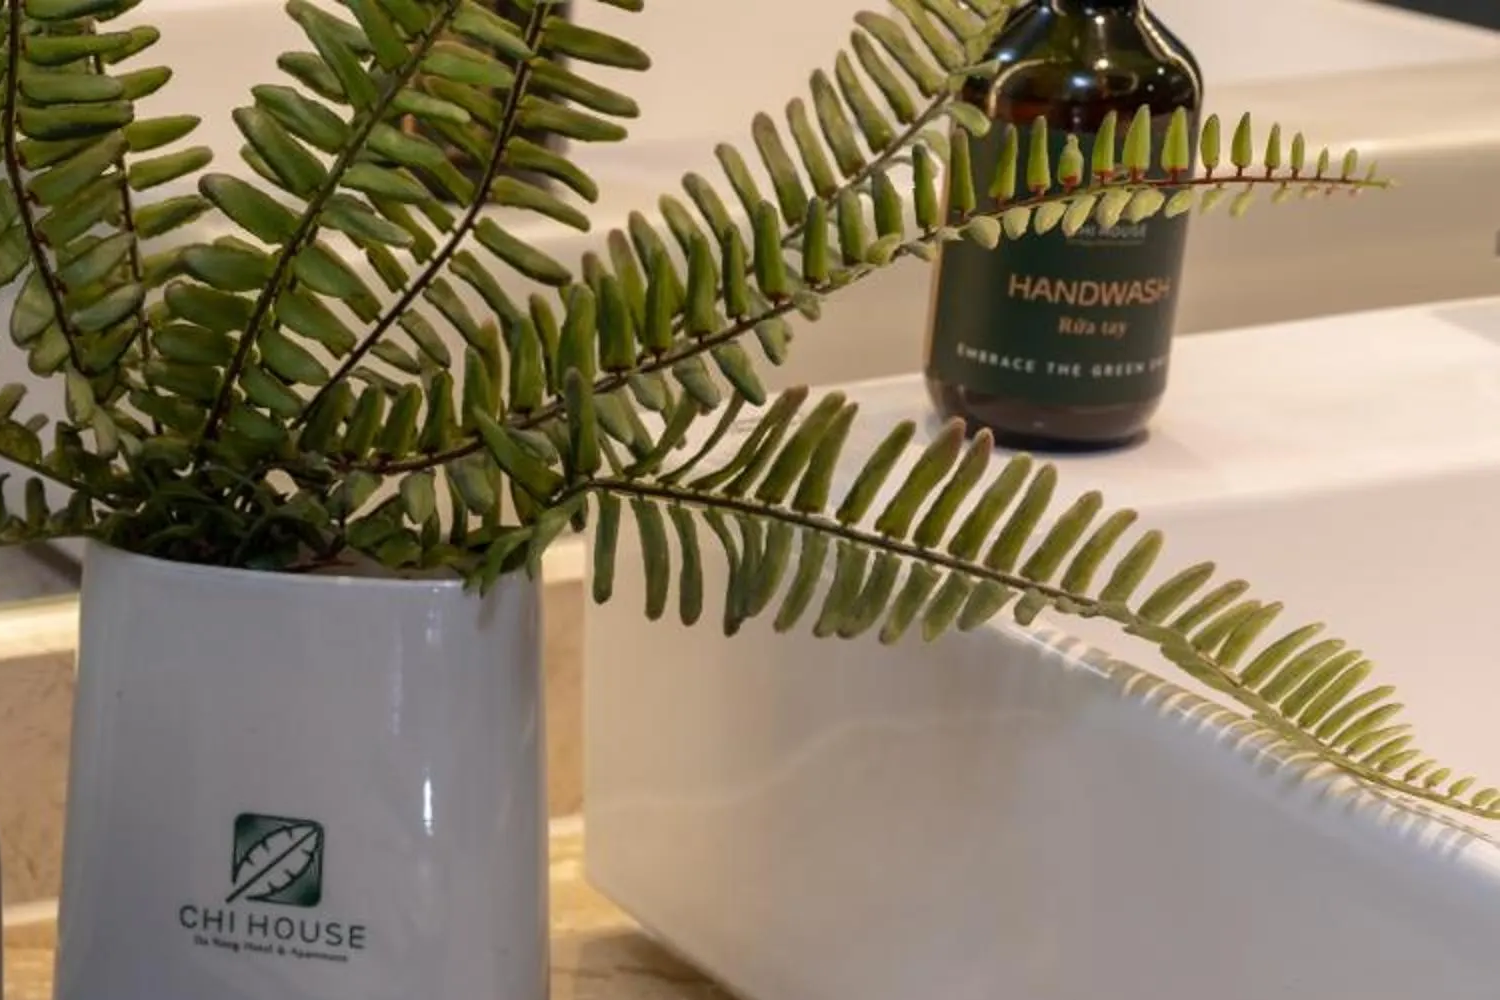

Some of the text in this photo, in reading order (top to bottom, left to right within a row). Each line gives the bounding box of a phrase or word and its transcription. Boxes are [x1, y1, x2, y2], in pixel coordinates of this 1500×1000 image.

[1008, 273, 1171, 307] HANDWASH
[1101, 319, 1128, 339] tay
[956, 342, 1036, 373] EMBRACE
[1046, 360, 1082, 377] THE
[1091, 360, 1146, 378] GREEN
[179, 904, 367, 950] CHI HOUSE
